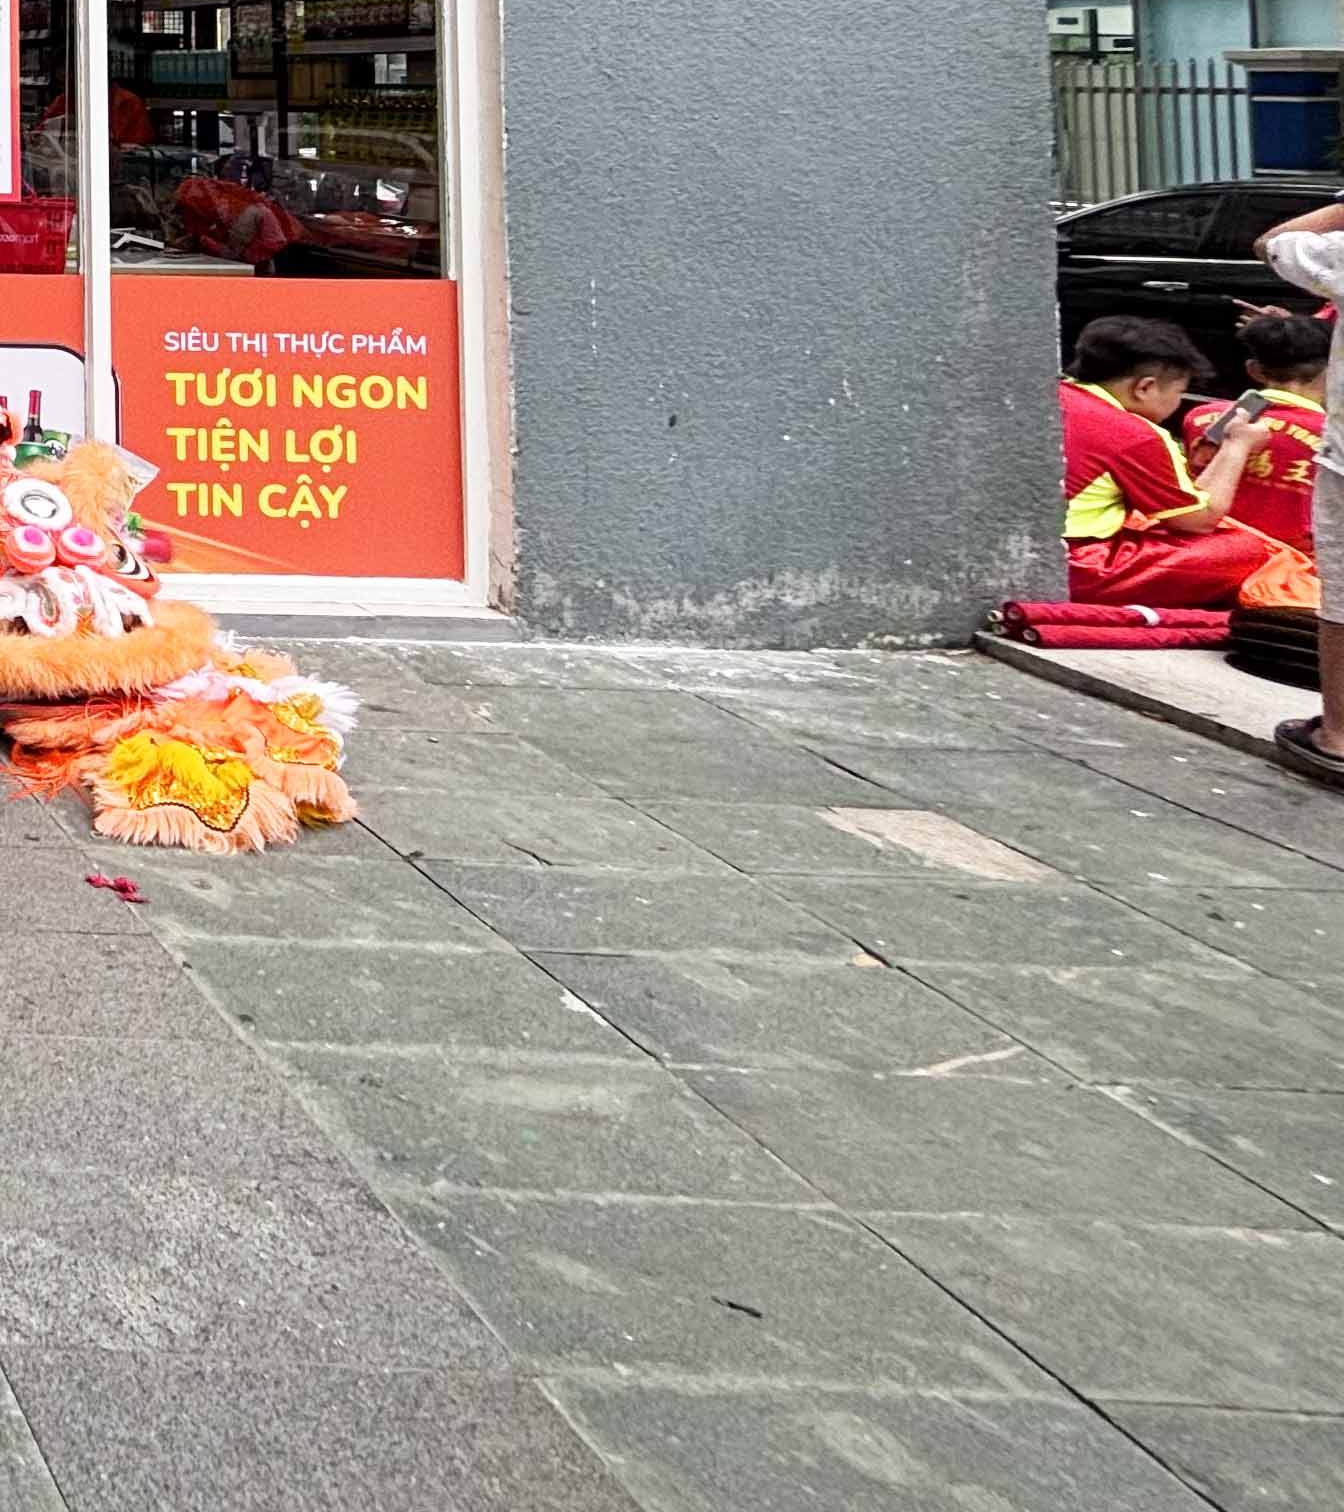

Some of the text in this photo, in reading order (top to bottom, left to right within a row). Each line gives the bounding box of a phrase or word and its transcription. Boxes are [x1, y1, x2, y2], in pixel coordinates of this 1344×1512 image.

[163, 326, 427, 358] SIÊU THỊ THỰC PHẨM
[165, 367, 428, 410] TƯƠI NGON
[165, 417, 358, 473] TIỆN LỢI
[165, 474, 348, 529] TIN CẬY
